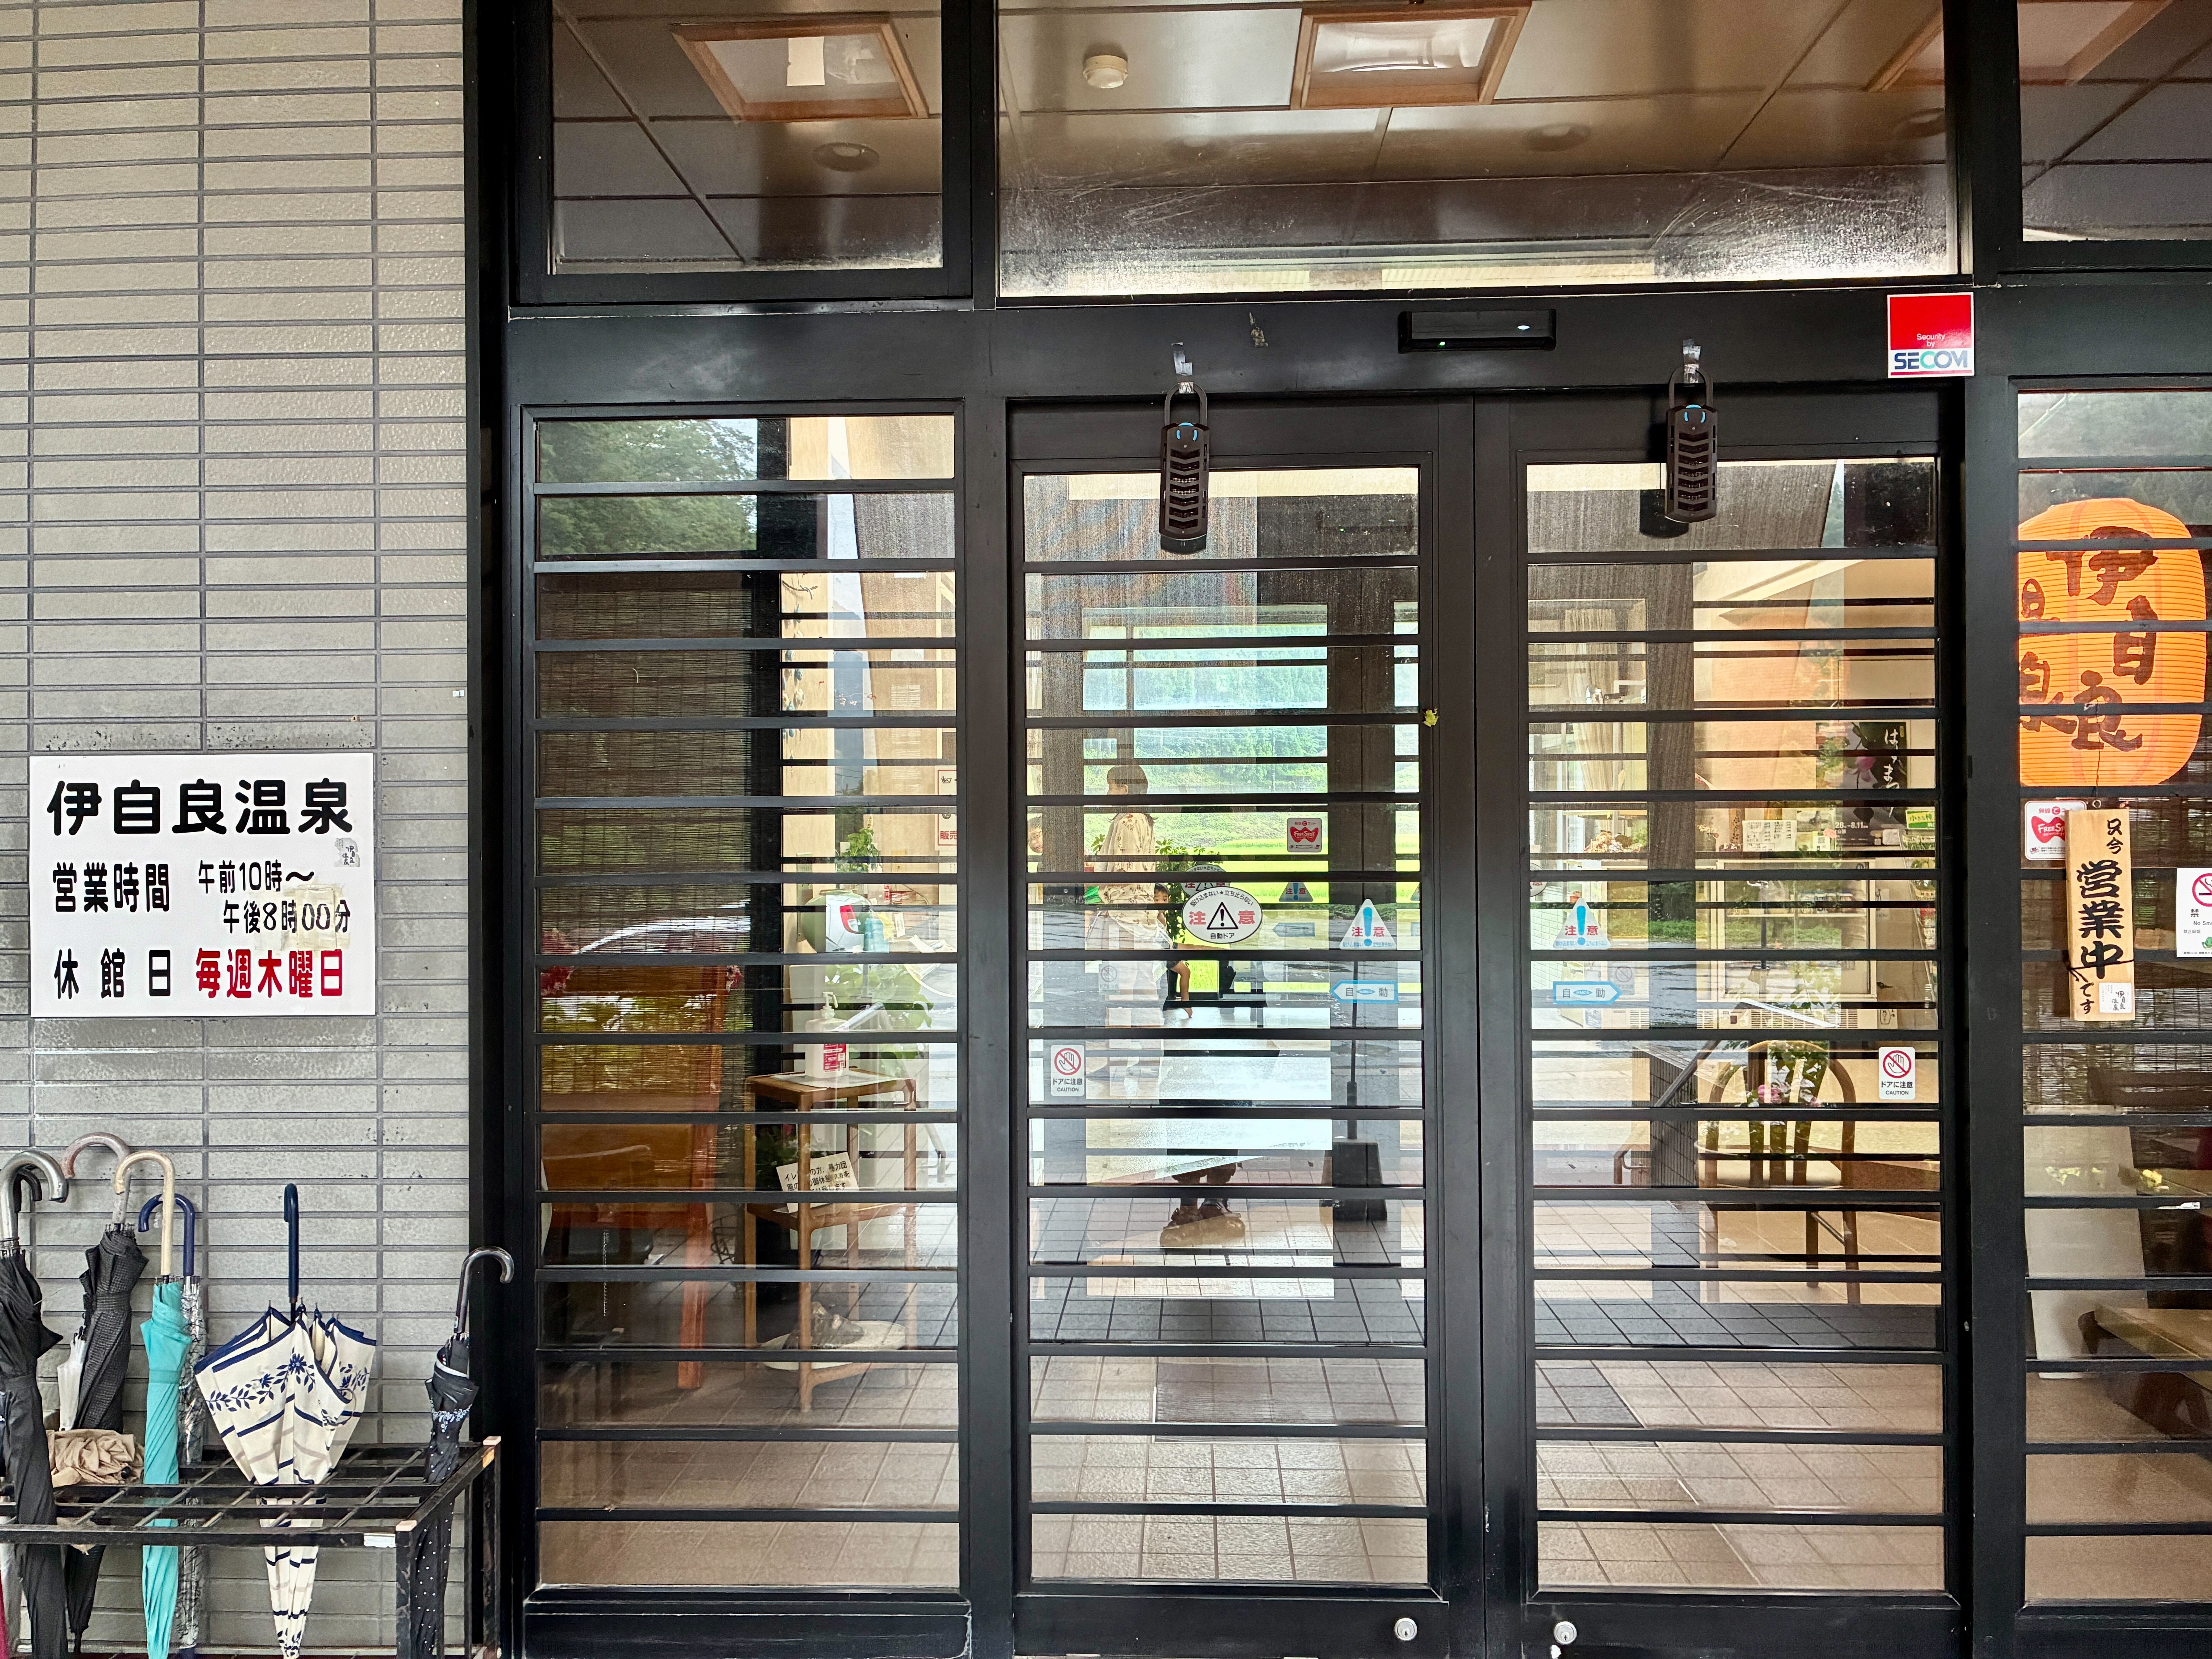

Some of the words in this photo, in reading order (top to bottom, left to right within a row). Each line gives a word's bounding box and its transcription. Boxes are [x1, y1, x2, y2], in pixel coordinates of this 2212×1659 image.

[1894, 350, 1968, 369] SECOM
[46, 778, 353, 836] 伊自良温泉
[2106, 818, 2124, 854] 只今
[52, 862, 170, 913] 営業時間
[223, 899, 351, 934] 午後8時00分
[1189, 911, 1206, 926] 注
[1238, 910, 1255, 925] 意
[2076, 859, 2124, 979] 営業中
[2190, 908, 2199, 917] 禁
[1352, 926, 1363, 937] 注
[1373, 927, 1385, 937] 意
[1565, 925, 1577, 936] 注
[1587, 926, 1598, 936] 意
[53, 947, 171, 999] 休館日
[196, 947, 343, 999] 毎週木曜日
[1346, 986, 1354, 997] 自
[1378, 987, 1388, 997] 動
[1563, 988, 1570, 998] 自
[1595, 988, 1605, 998] 動
[2080, 982, 2095, 1014] です
